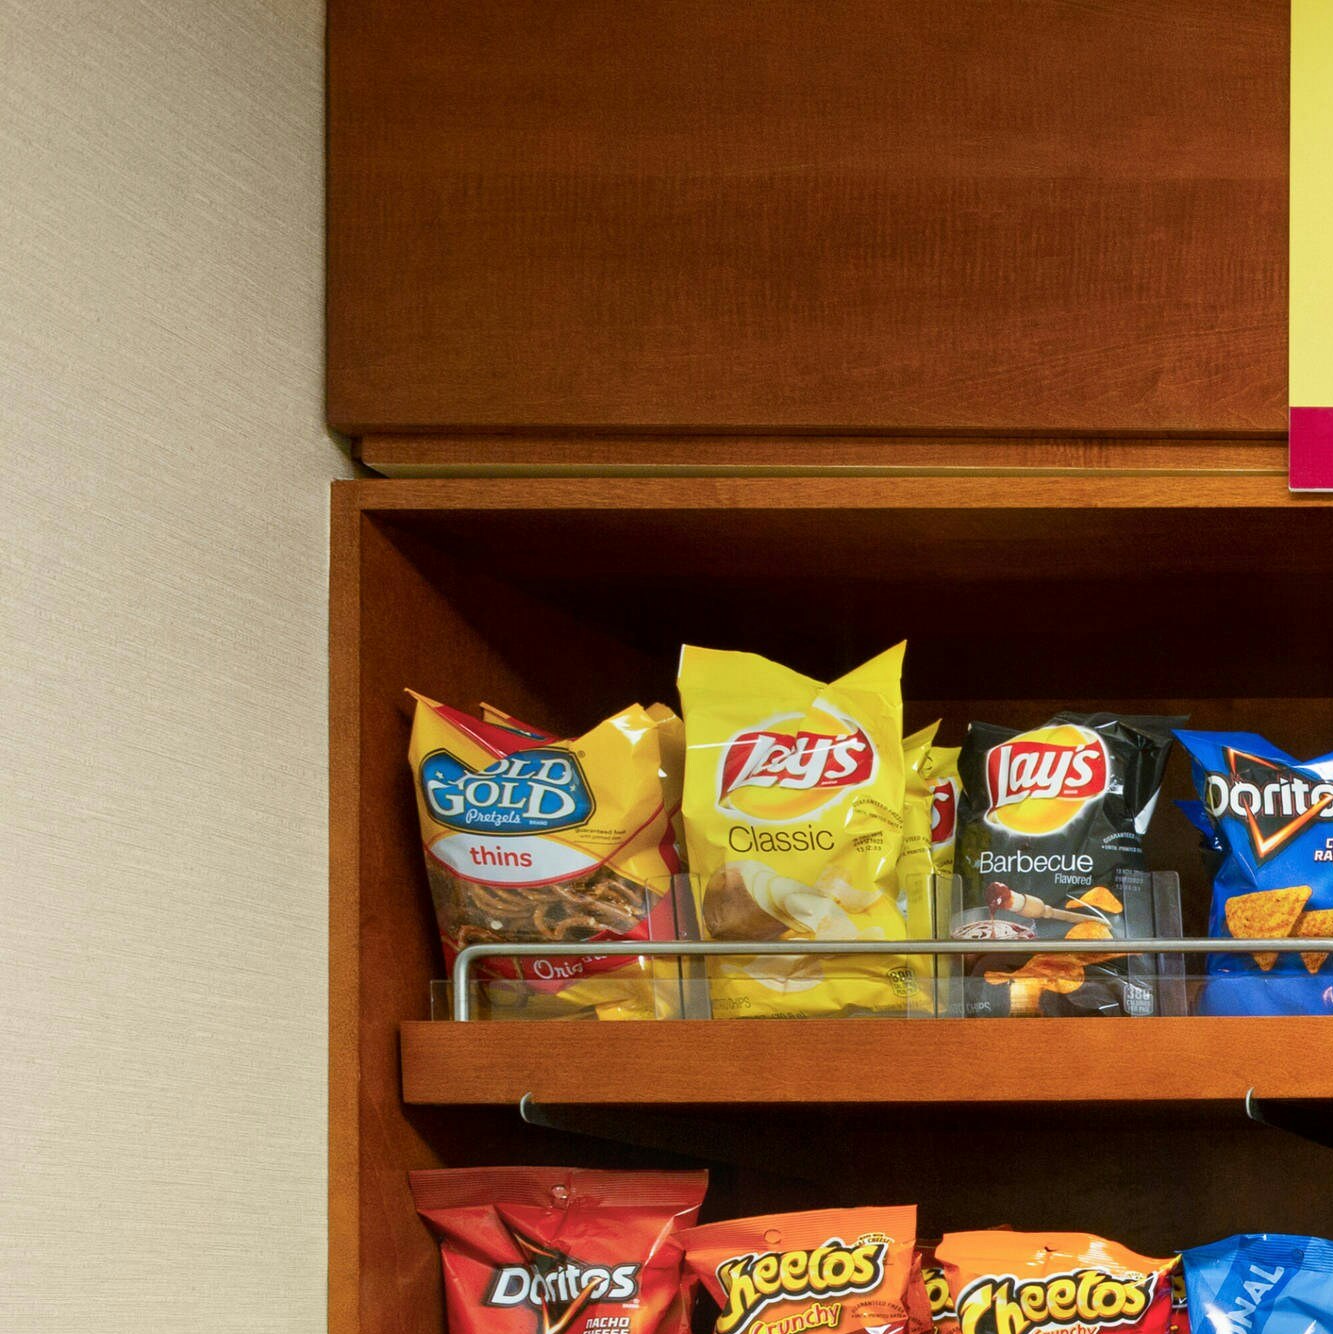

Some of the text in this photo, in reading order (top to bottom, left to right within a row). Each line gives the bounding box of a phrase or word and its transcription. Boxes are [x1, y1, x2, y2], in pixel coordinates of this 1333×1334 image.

[727, 728, 873, 792] Lay's
[997, 741, 1099, 807] Lay's
[428, 780, 576, 820] GOLD
[465, 809, 521, 827] Pretzels
[729, 824, 835, 853] Classic
[469, 846, 533, 867] thins
[979, 850, 1093, 874] Barbecue
[1054, 873, 1092, 886] Flavored
[491, 1263, 638, 1305] Doritos
[586, 1317, 630, 1329] NACHO
